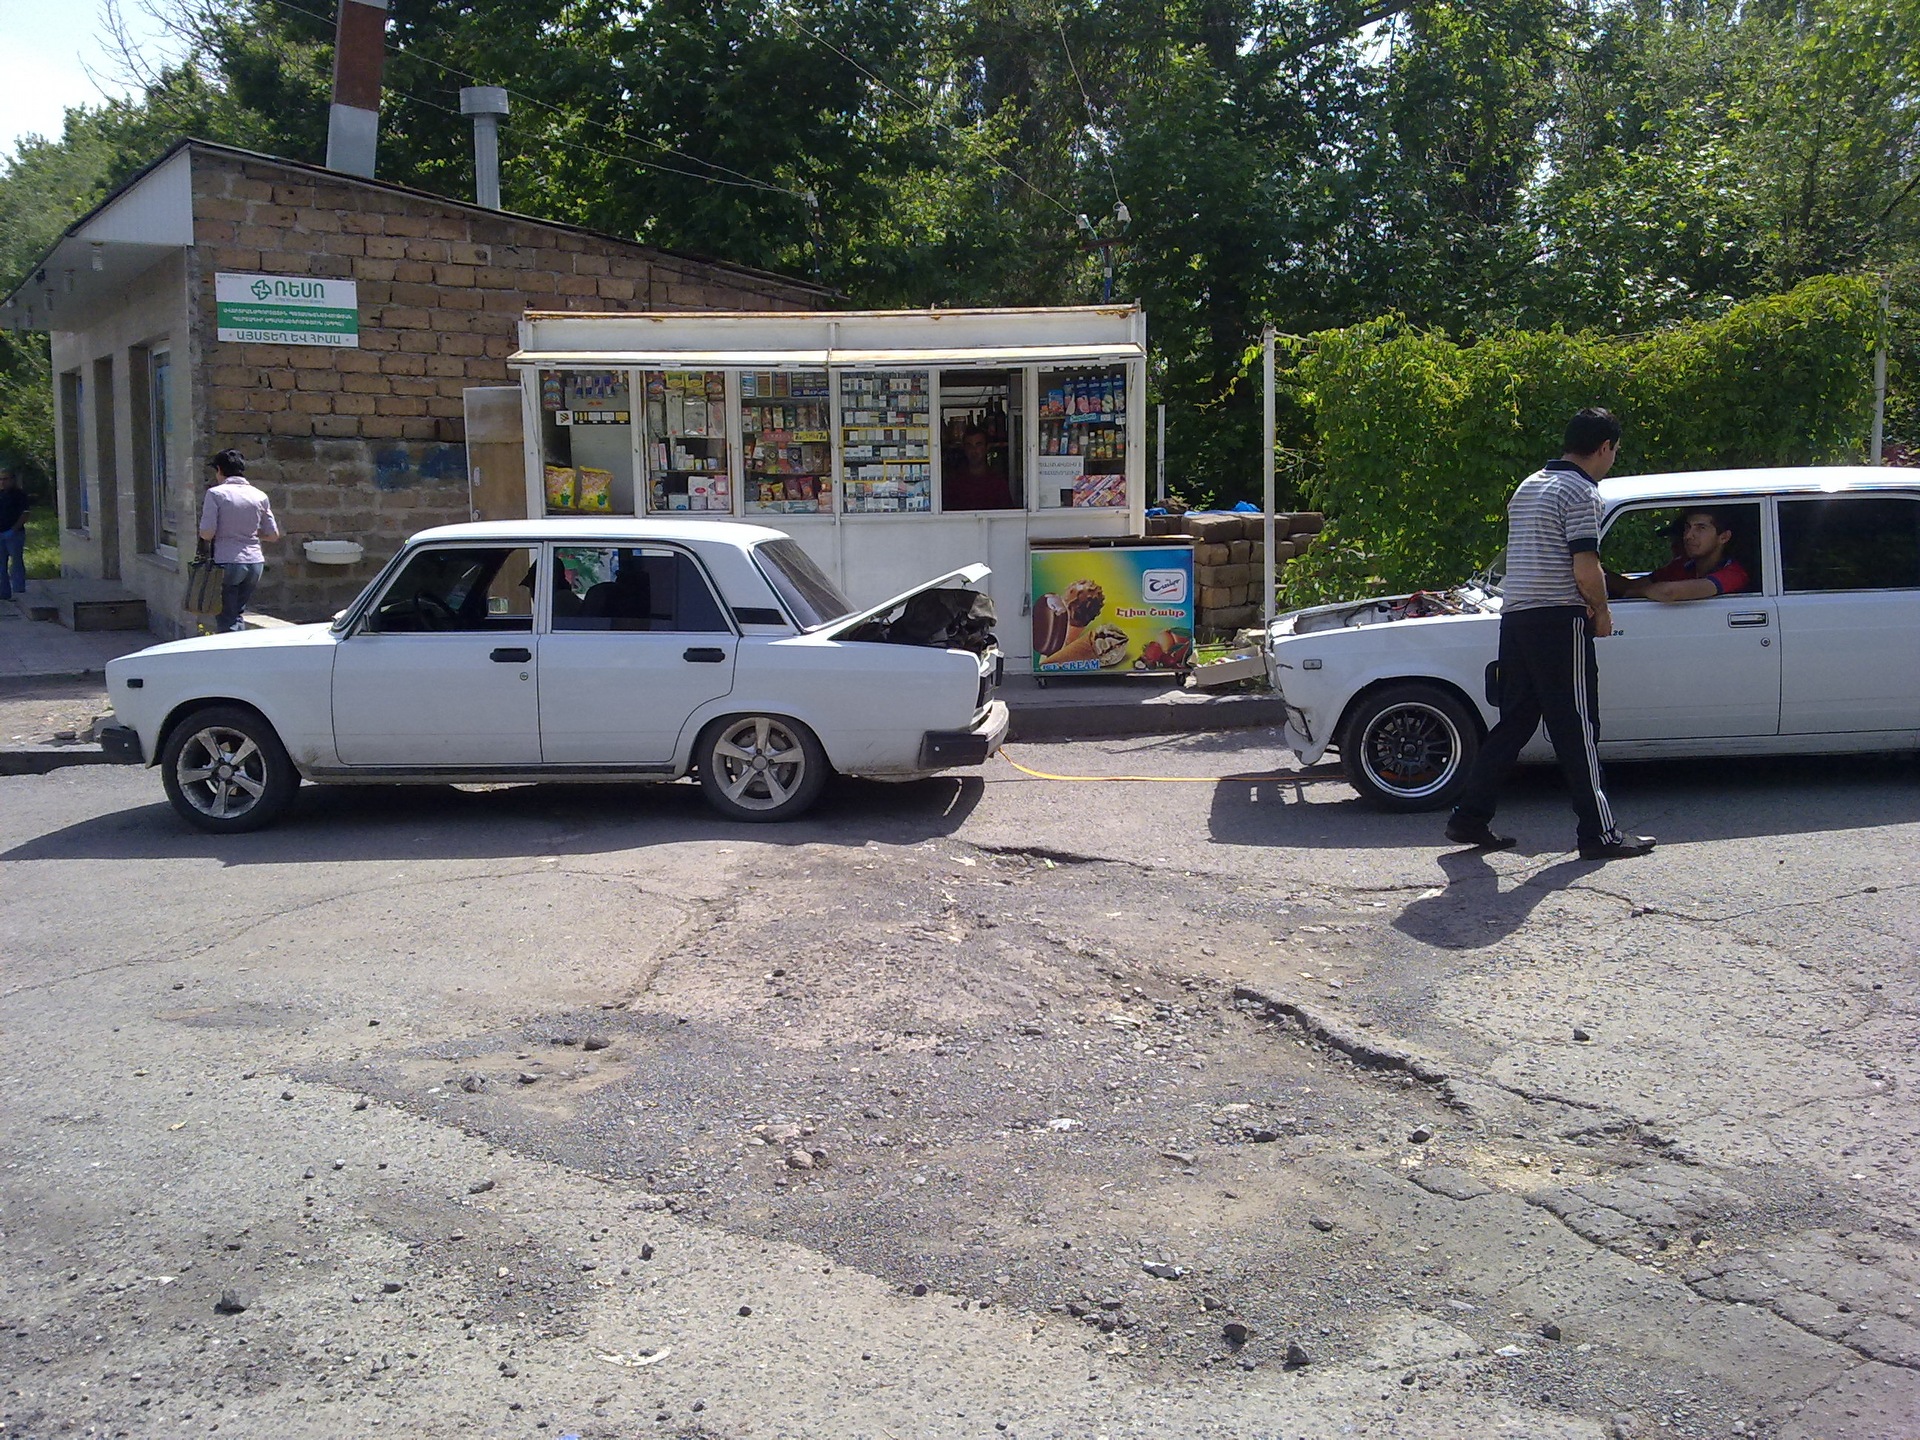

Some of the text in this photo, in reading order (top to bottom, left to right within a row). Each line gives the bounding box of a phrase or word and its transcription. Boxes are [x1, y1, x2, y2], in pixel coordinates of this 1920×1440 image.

[236, 330, 288, 342] ԱՅՍՏԵՂ
[291, 333, 307, 343] ԵՎ
[1062, 659, 1099, 670] CREAM
